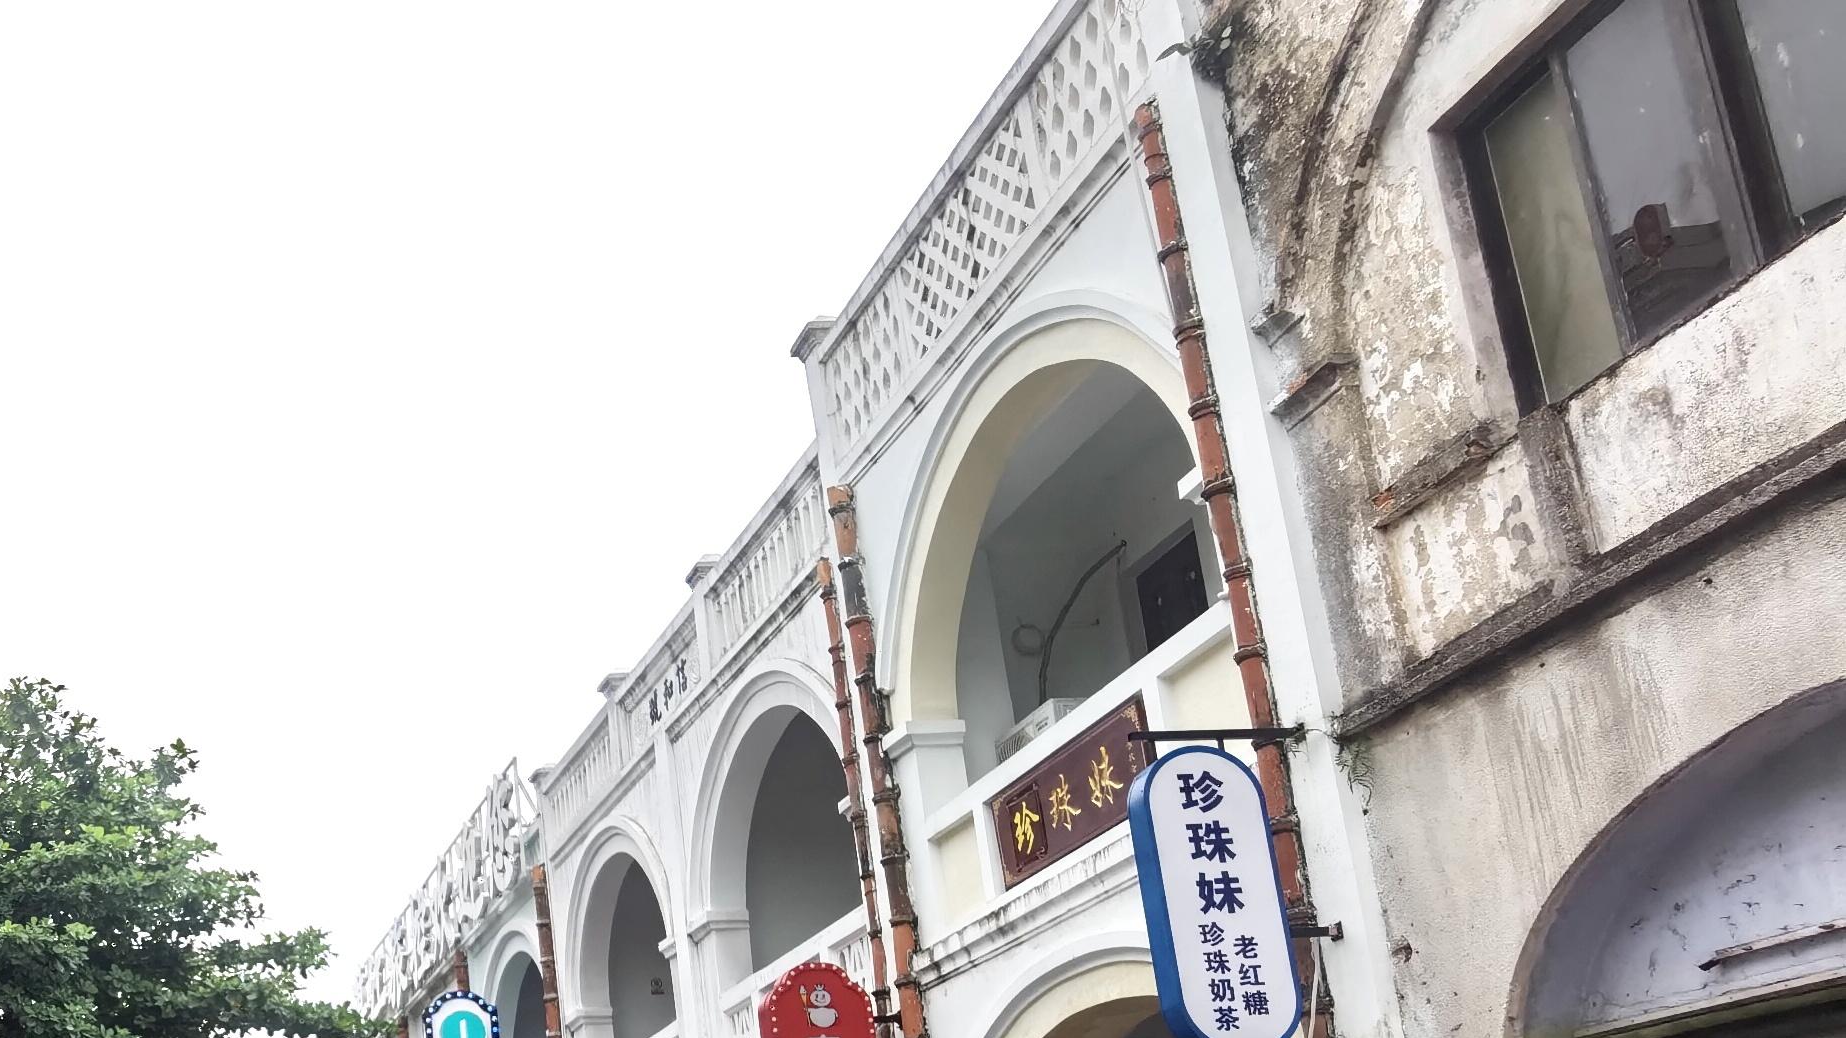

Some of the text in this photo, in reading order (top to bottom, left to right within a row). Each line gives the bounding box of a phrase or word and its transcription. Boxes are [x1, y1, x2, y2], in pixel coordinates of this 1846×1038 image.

[1013, 746, 1124, 853] 珍珠妹
[1177, 770, 1245, 916] 珍珠妹
[1198, 921, 1240, 1033] 珍珠奶茶
[1233, 935, 1269, 1016] 老红糖
